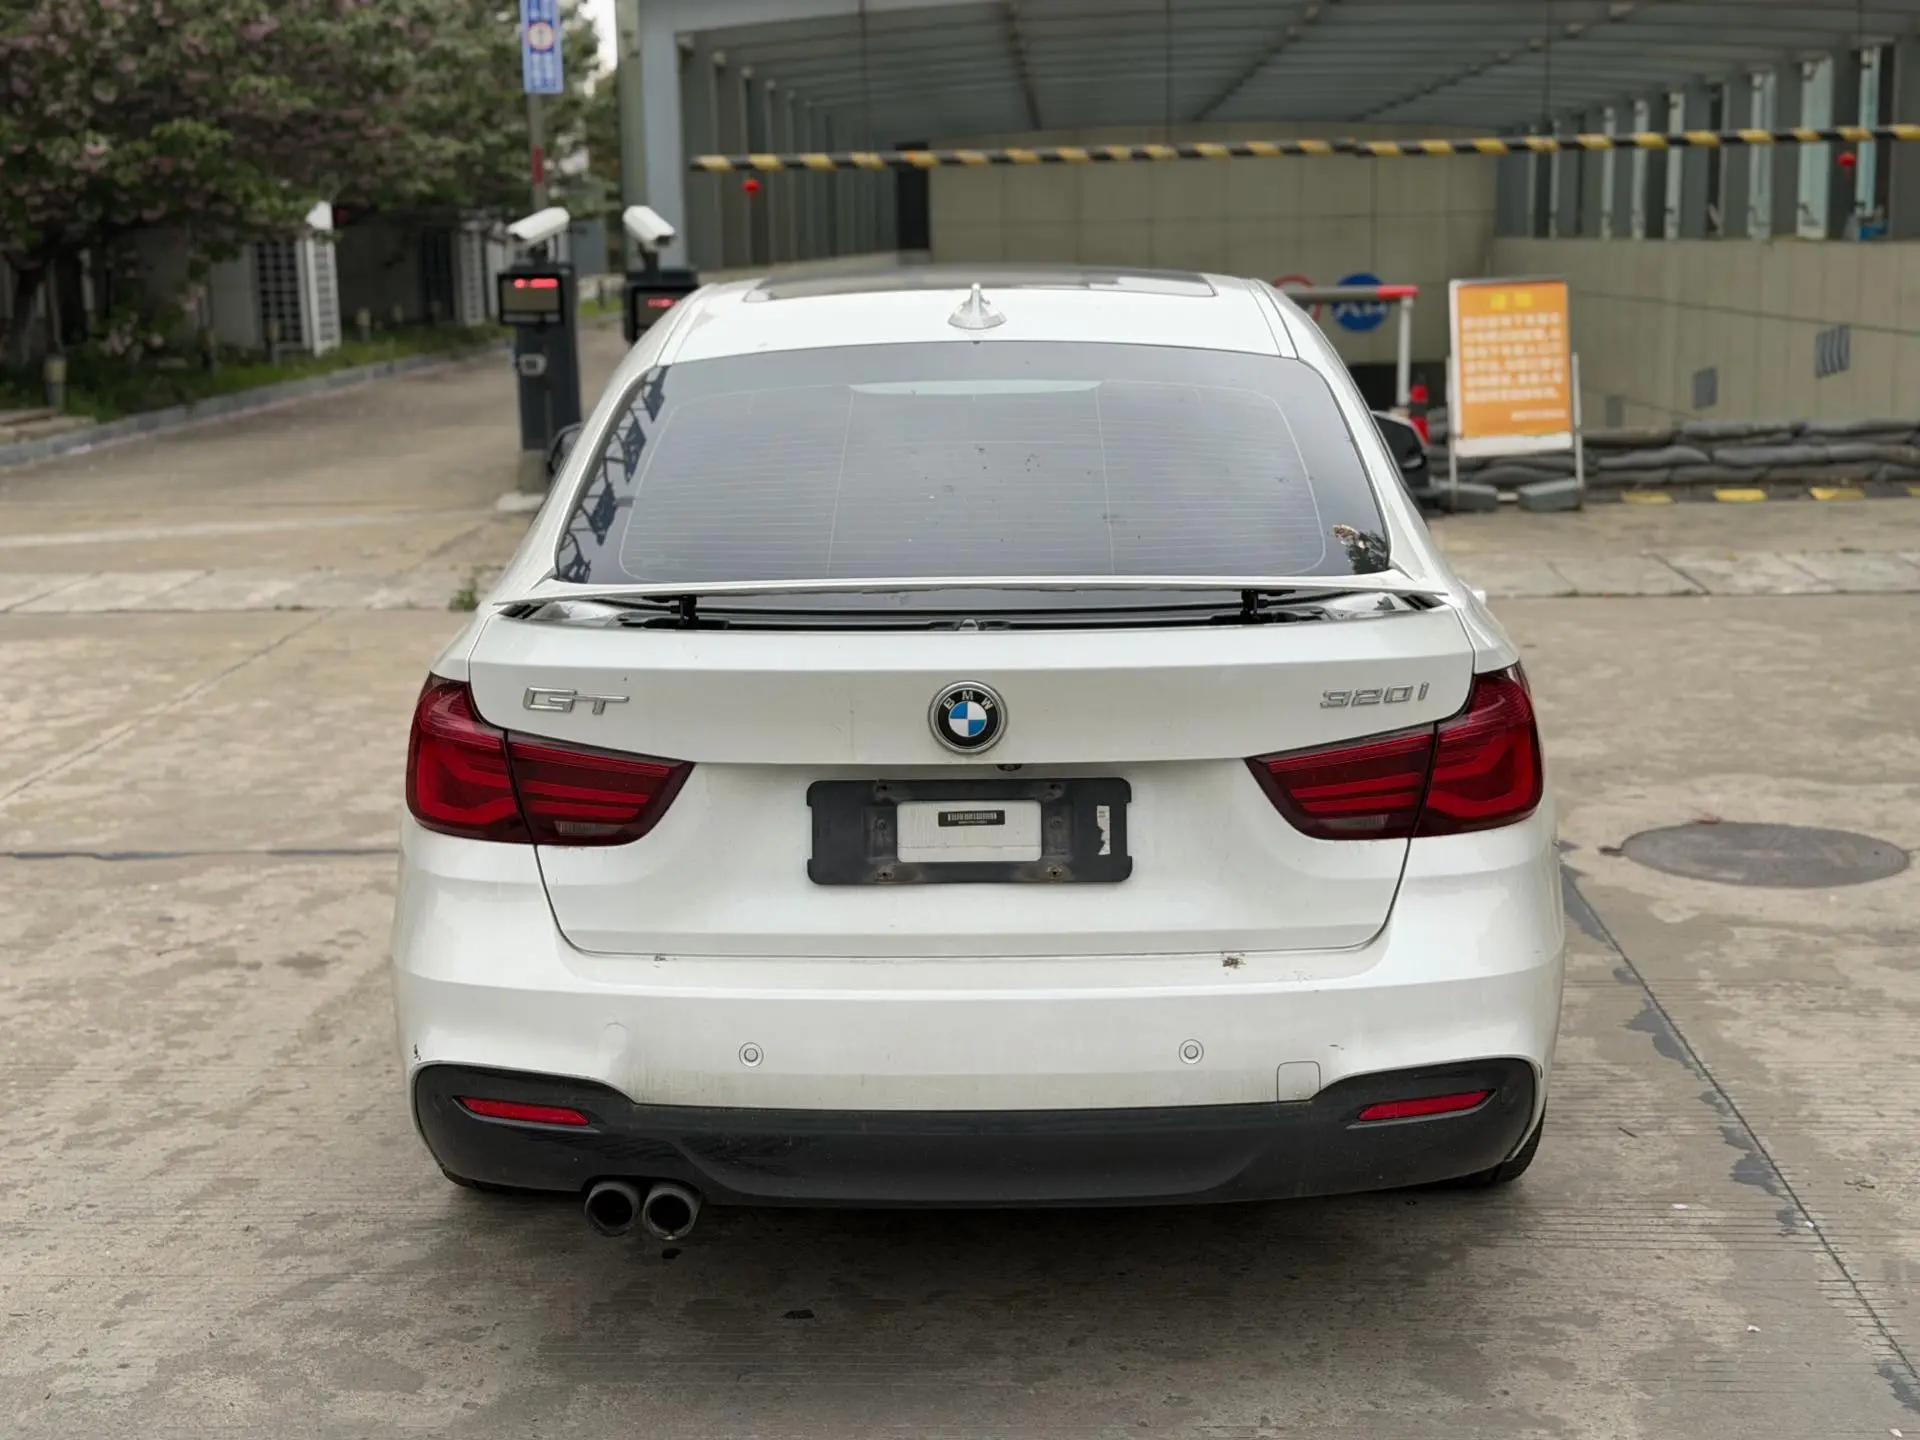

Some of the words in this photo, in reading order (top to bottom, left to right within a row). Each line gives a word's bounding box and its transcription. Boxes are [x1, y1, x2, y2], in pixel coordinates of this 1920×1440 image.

[522, 686, 630, 716] GT
[943, 690, 994, 711] BMW
[1319, 681, 1430, 709] 320i
